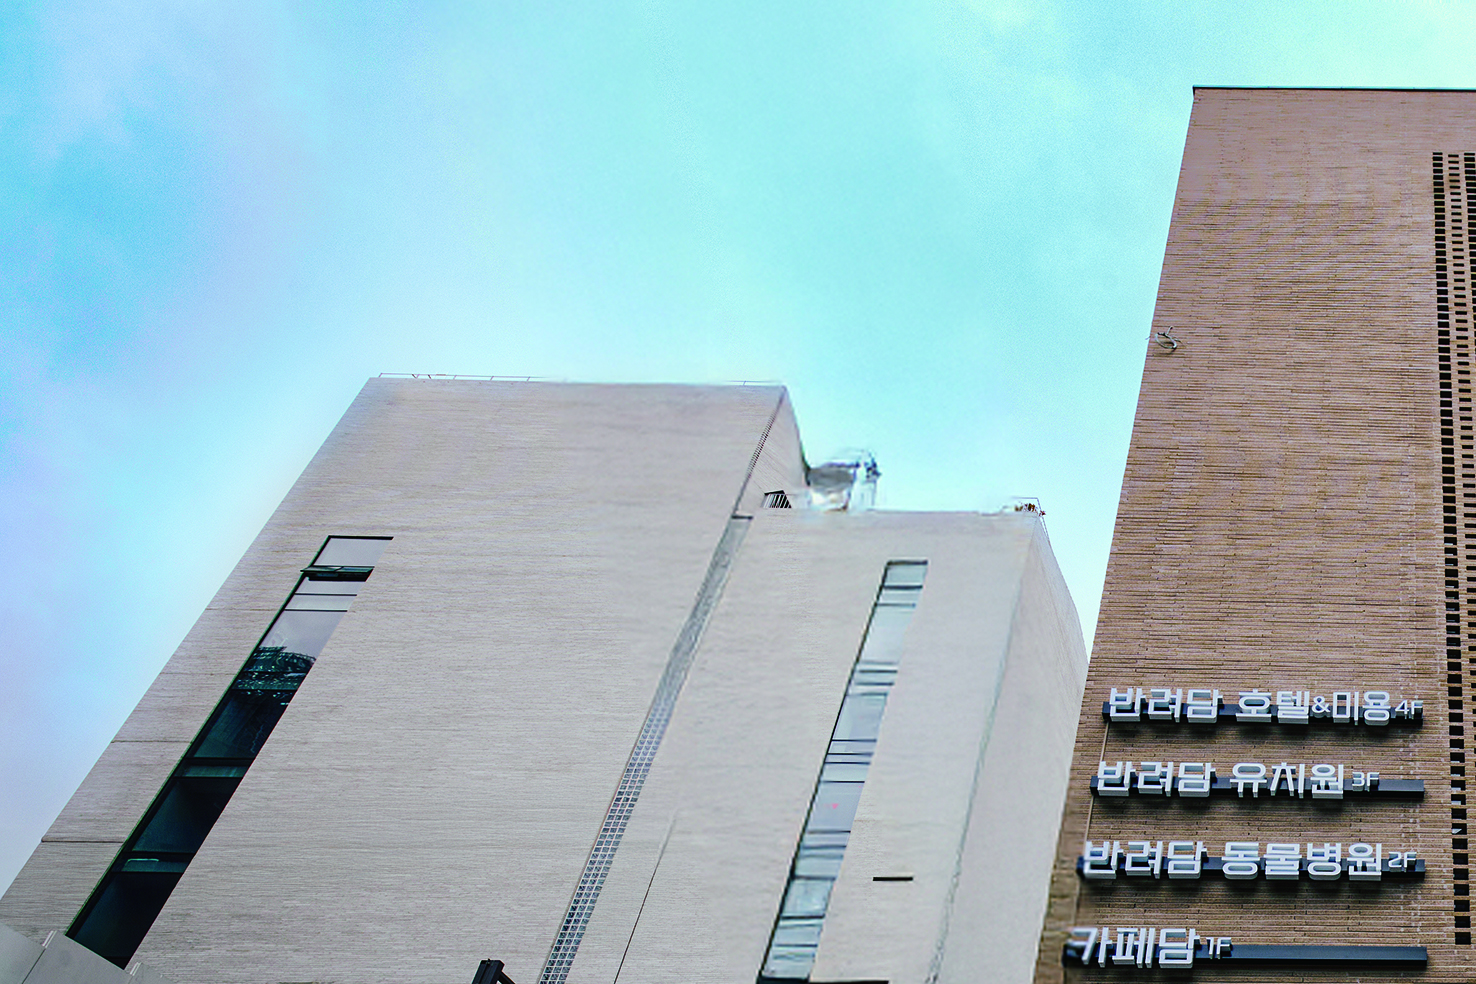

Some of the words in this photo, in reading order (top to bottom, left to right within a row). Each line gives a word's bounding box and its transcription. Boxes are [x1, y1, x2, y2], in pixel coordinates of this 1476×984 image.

[1109, 687, 1224, 724] 반려담
[1235, 688, 1392, 726] 호텔&미용
[1395, 698, 1424, 721] 4F
[1097, 761, 1217, 798] 반려담
[1230, 762, 1345, 800] 유치원
[1351, 771, 1380, 793] 3F
[1083, 840, 1208, 880] 반려담
[1221, 842, 1383, 881] 동물병원
[1388, 851, 1418, 873] 2F
[1066, 926, 1201, 969] 카페담
[1206, 937, 1232, 960] 1F
